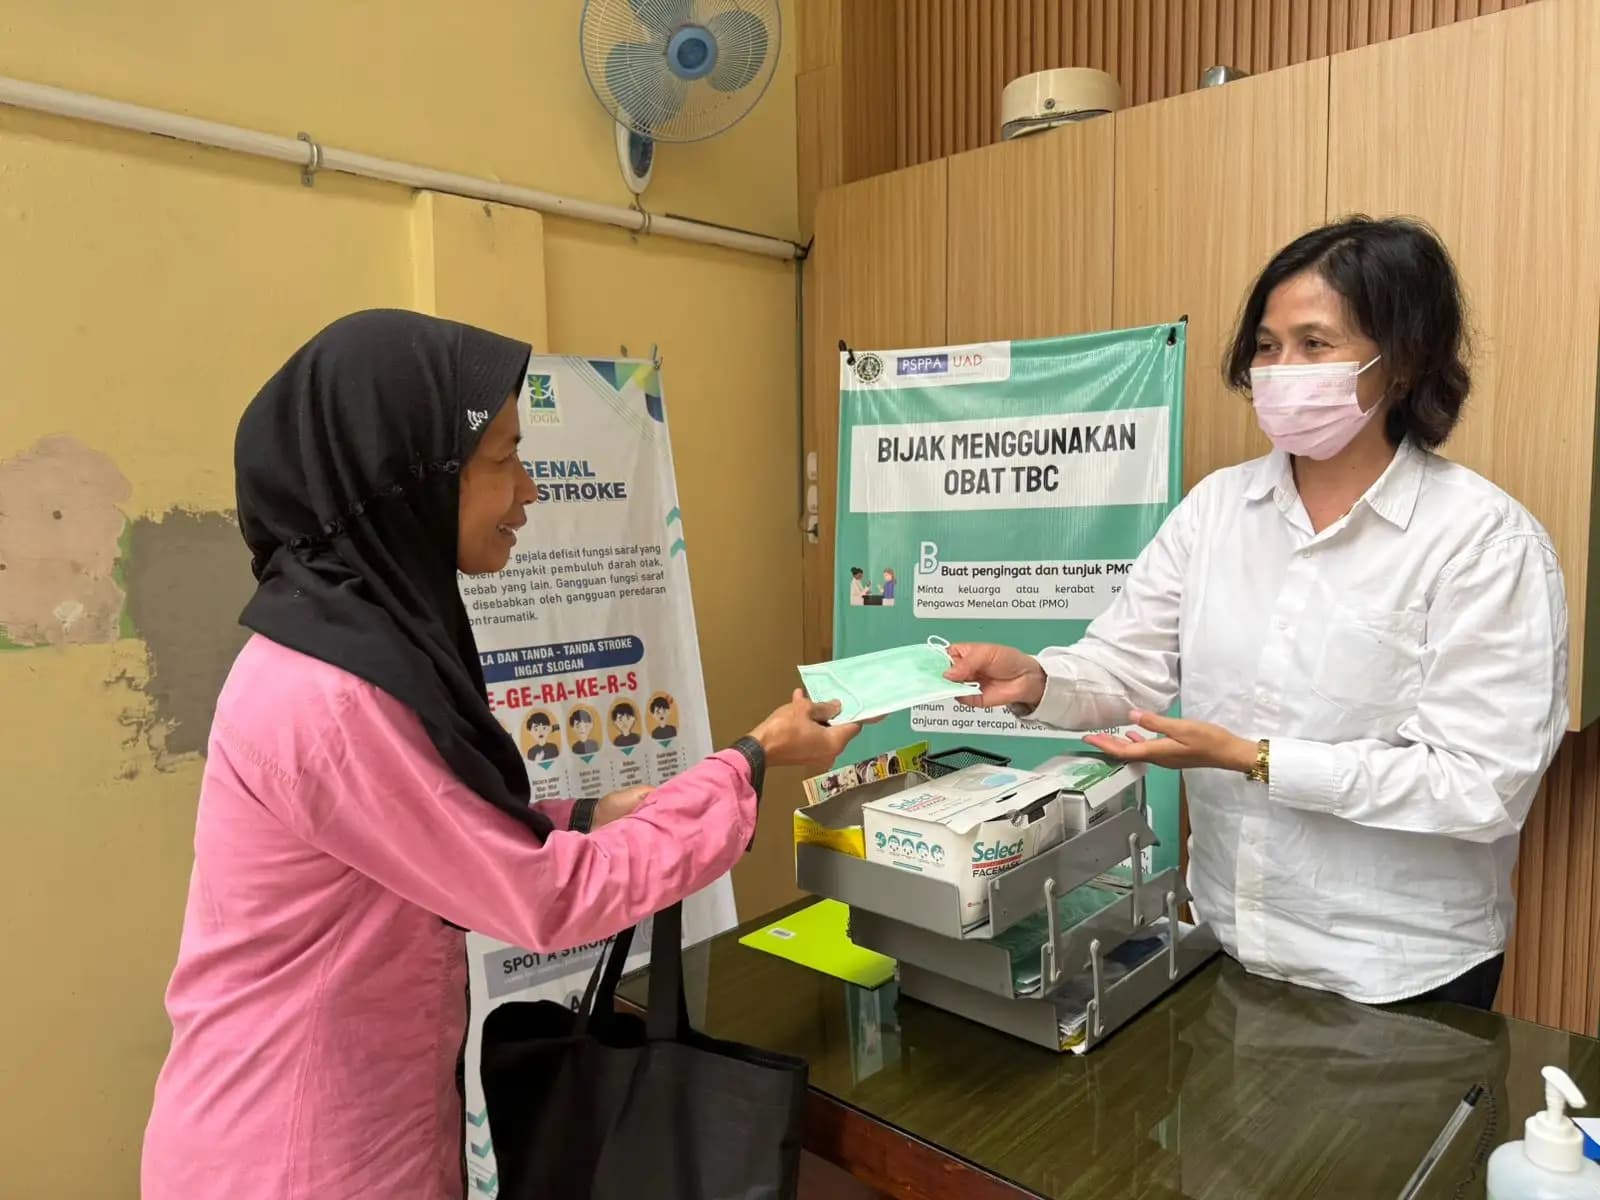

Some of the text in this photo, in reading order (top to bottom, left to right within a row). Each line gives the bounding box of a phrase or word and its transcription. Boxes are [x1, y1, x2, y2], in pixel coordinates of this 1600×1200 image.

[902, 354, 983, 371] PSPPA UAD
[878, 423, 1136, 463] BIJAK MENGGUNAKAN
[943, 464, 1059, 496] OBAT TBC
[536, 482, 627, 501] STROKE
[515, 551, 547, 564] gejala
[582, 546, 613, 559] fungsi
[615, 544, 638, 555] saraf
[639, 545, 661, 556] yang
[919, 540, 939, 575] B
[499, 565, 546, 579] penyakit
[551, 561, 604, 576] pembuluh
[607, 560, 637, 570] darah
[941, 565, 969, 576] Buat
[972, 564, 1032, 579] pengingat
[1035, 564, 1059, 576] dan
[1062, 563, 1102, 578] tunjuk
[463, 583, 497, 596] sebab
[501, 583, 527, 595] yang
[556, 576, 607, 589] Gangguan
[609, 572, 639, 584] fungsi
[640, 570, 664, 581] saraf
[917, 585, 944, 594] Minta
[958, 585, 1001, 596] keluarga
[1016, 585, 1039, 594] atau
[1055, 584, 1095, 594] kerabat
[472, 586, 666, 611] disebabkan oleh gangguan peredaran
[917, 599, 1069, 610] Pengawas Menelan Obat (PMO)
[497, 652, 519, 664] DAN
[522, 648, 554, 661] TANDA
[563, 642, 596, 656] TANDA
[598, 637, 633, 652] STROKE
[514, 658, 585, 678] INGAT SLOGAN
[912, 716, 949, 727] anjuran
[952, 718, 974, 729] agar
[977, 719, 1017, 731] tercapai
[971, 838, 1024, 862] Select
[503, 952, 541, 975] SPOT
